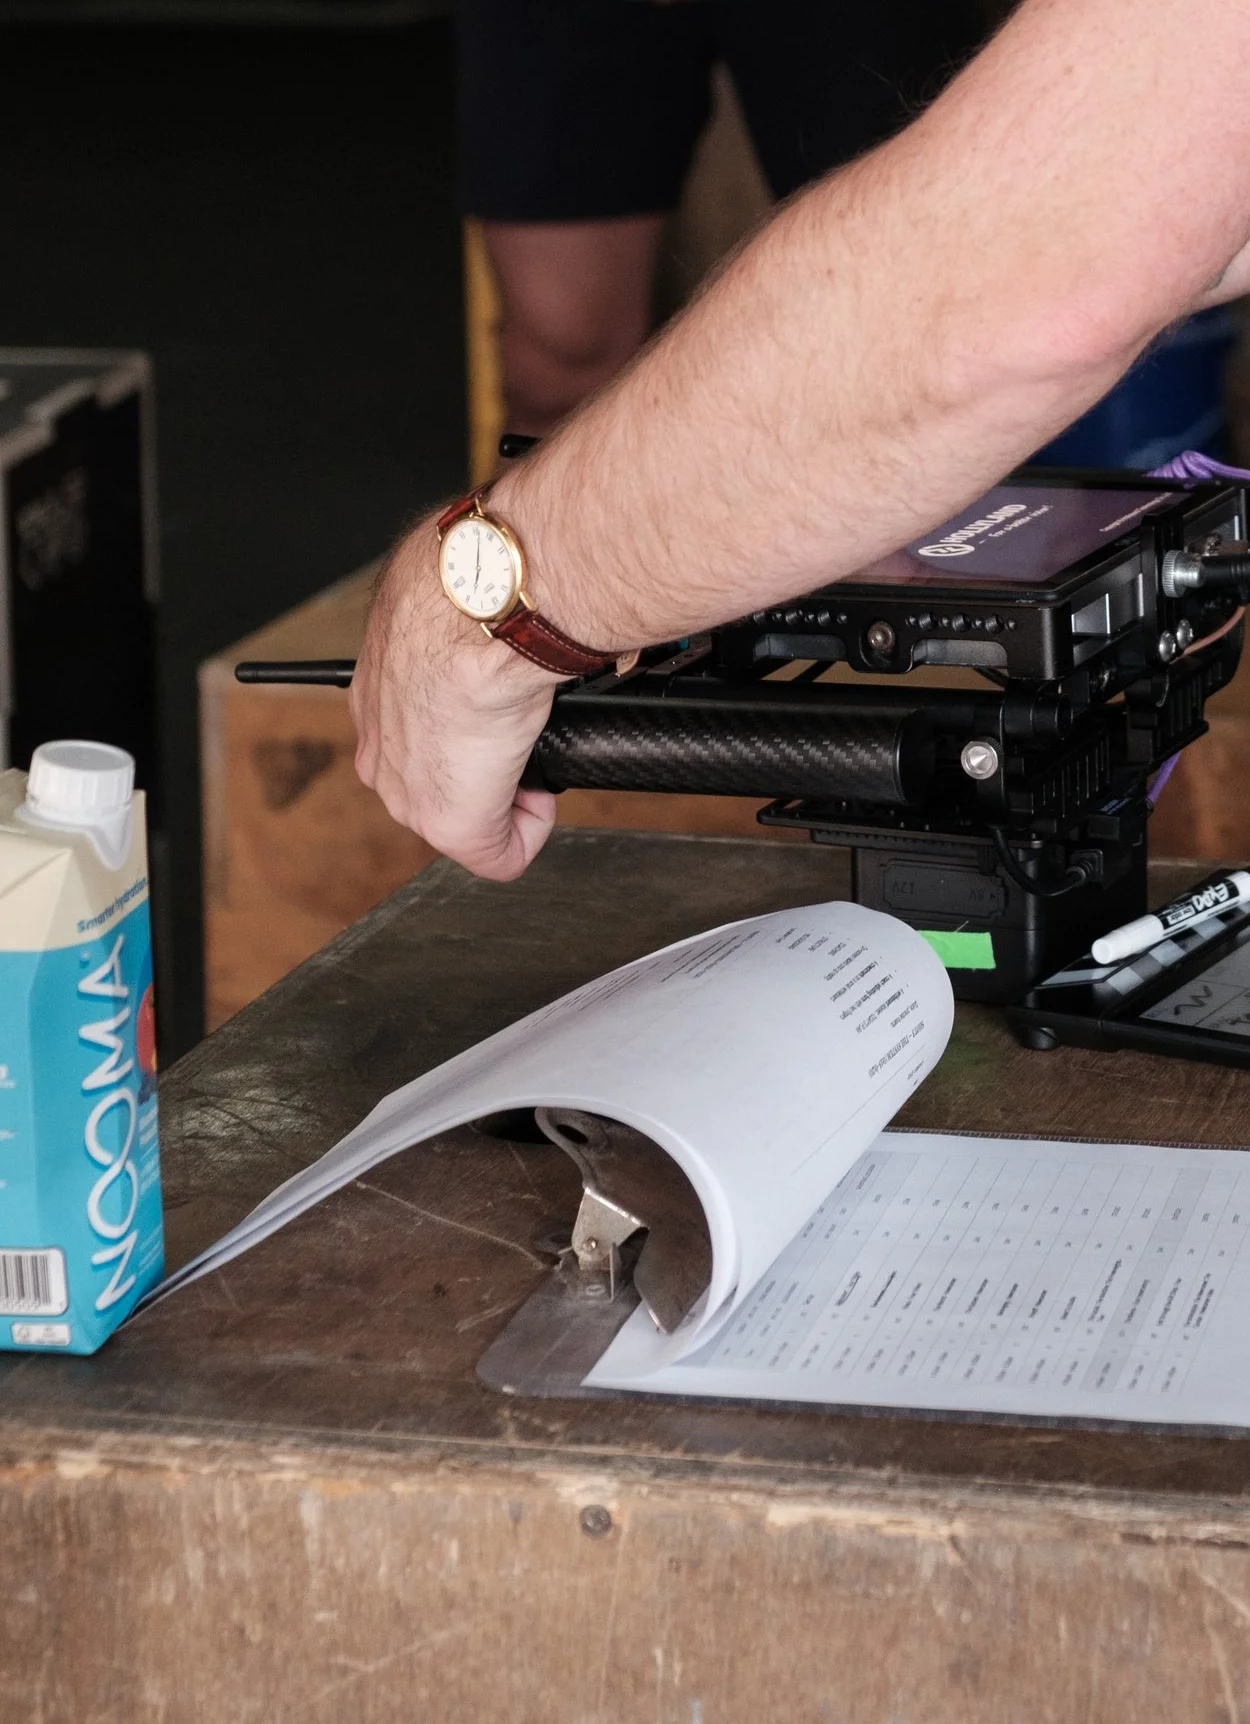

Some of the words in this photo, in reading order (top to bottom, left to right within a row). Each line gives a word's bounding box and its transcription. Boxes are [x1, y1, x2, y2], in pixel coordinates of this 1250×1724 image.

[938, 503, 1027, 544] HOLLYLAND
[1191, 882, 1230, 911] EXPO
[77, 902, 115, 932] Smarter
[77, 933, 141, 1311] NOOMA
